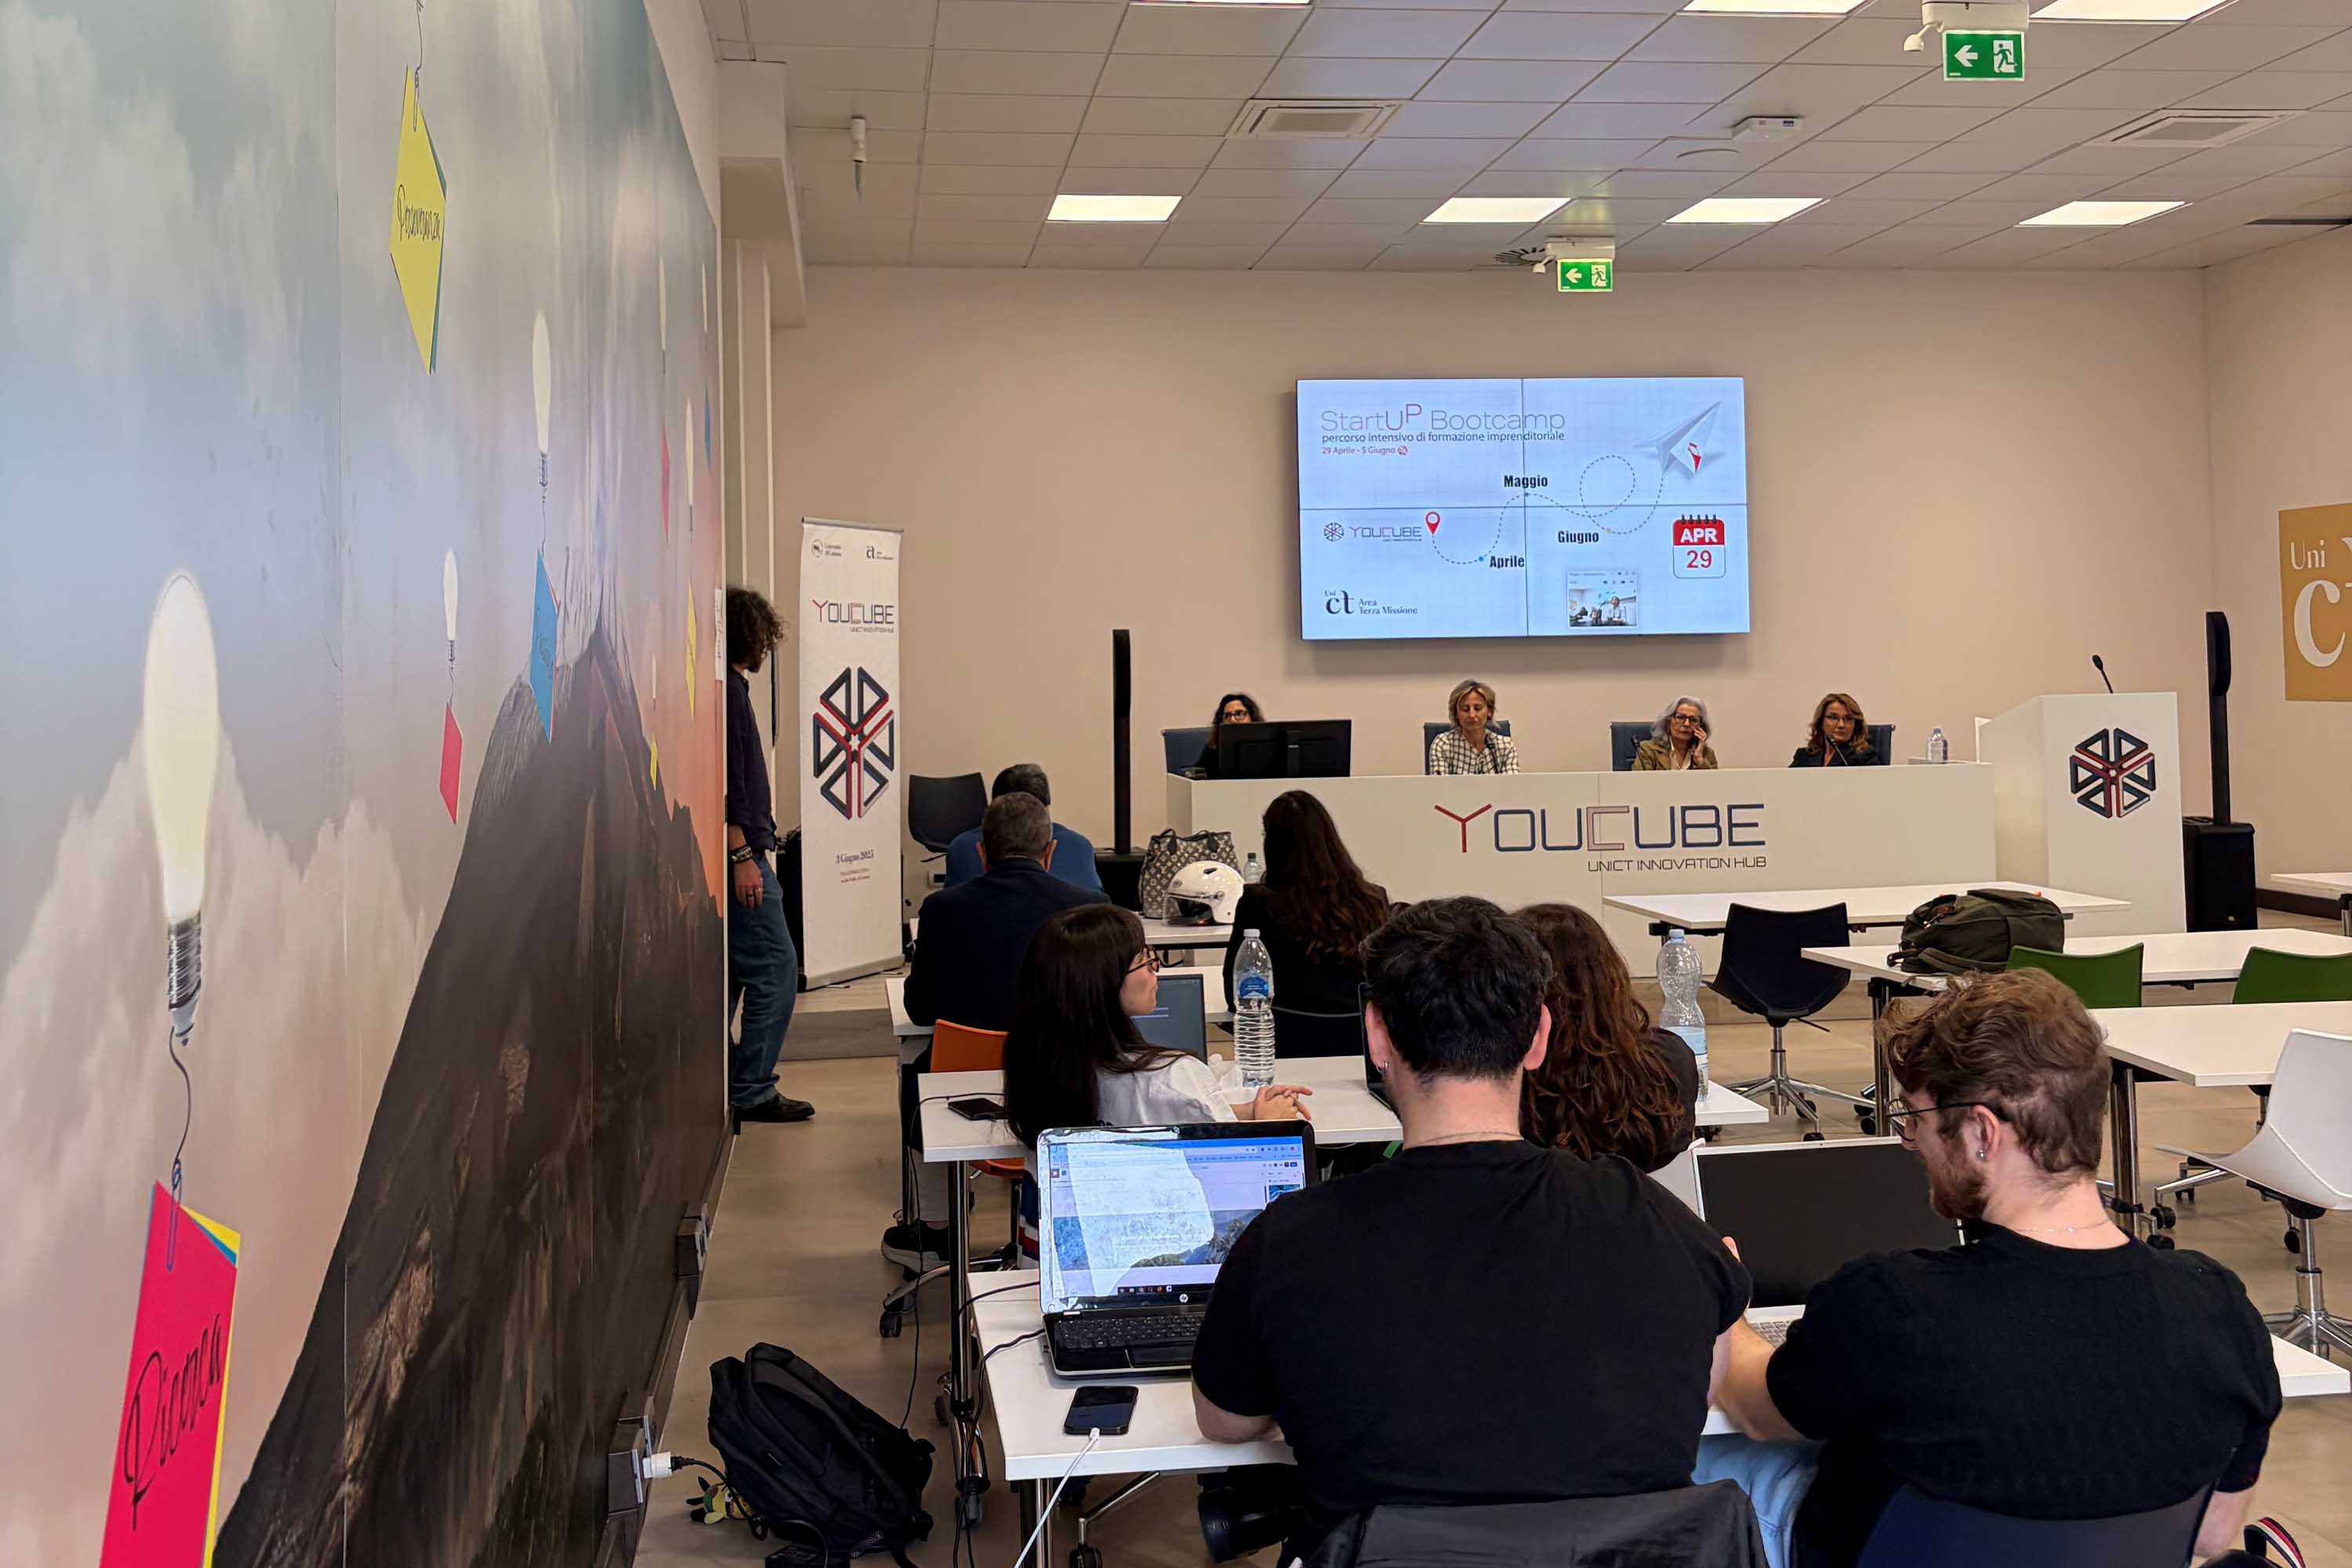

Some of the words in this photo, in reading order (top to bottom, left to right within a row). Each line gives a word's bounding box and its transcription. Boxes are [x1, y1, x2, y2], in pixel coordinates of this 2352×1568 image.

[1321, 403, 1423, 432] StartUP
[1431, 409, 1566, 433] Bootcamp
[1322, 434, 1366, 445] percorso
[1368, 432, 1414, 442] intensivo
[1416, 432, 1426, 441] di
[1428, 431, 1485, 442] formazione
[1486, 430, 1565, 444] imprenditoriale
[1333, 446, 1356, 456] Aprile
[1367, 446, 1396, 456] Giugno
[1503, 475, 1548, 488] Maggio
[1348, 526, 1423, 539] YOUCUBE
[1557, 530, 1599, 544] Giugno
[1680, 527, 1718, 543] APR
[1490, 555, 1525, 569] Aprile
[1686, 549, 1712, 569] 29
[2289, 539, 2326, 570] Uni
[811, 599, 895, 625] YOUCUBE
[1382, 606, 1418, 615] Missione
[1433, 803, 1766, 854] YOUCUBE
[1587, 858, 1634, 873] UNICT
[1636, 857, 1731, 871] INNOVATION
[1733, 856, 1767, 869] HUB
